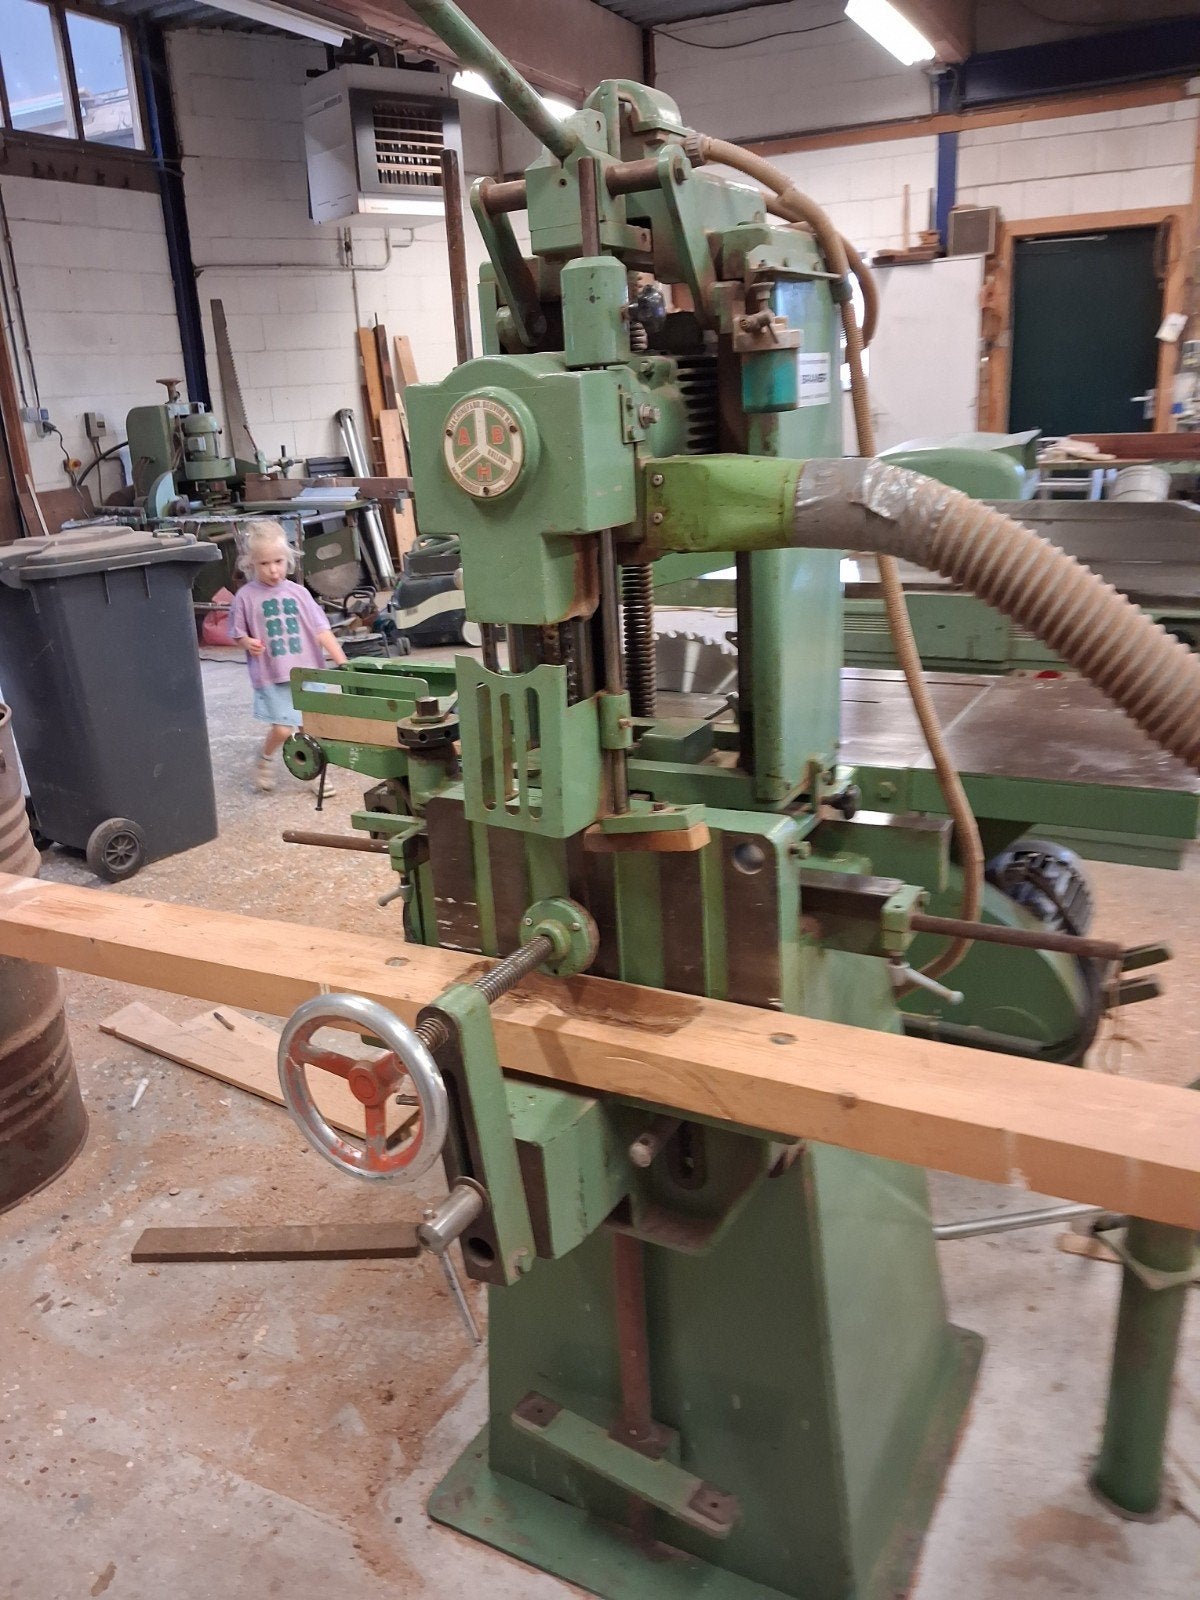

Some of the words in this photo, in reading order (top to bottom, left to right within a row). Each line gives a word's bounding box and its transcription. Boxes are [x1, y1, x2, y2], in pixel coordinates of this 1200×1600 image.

[458, 427, 471, 446] A
[491, 426, 505, 445] B
[477, 463, 493, 482] H
